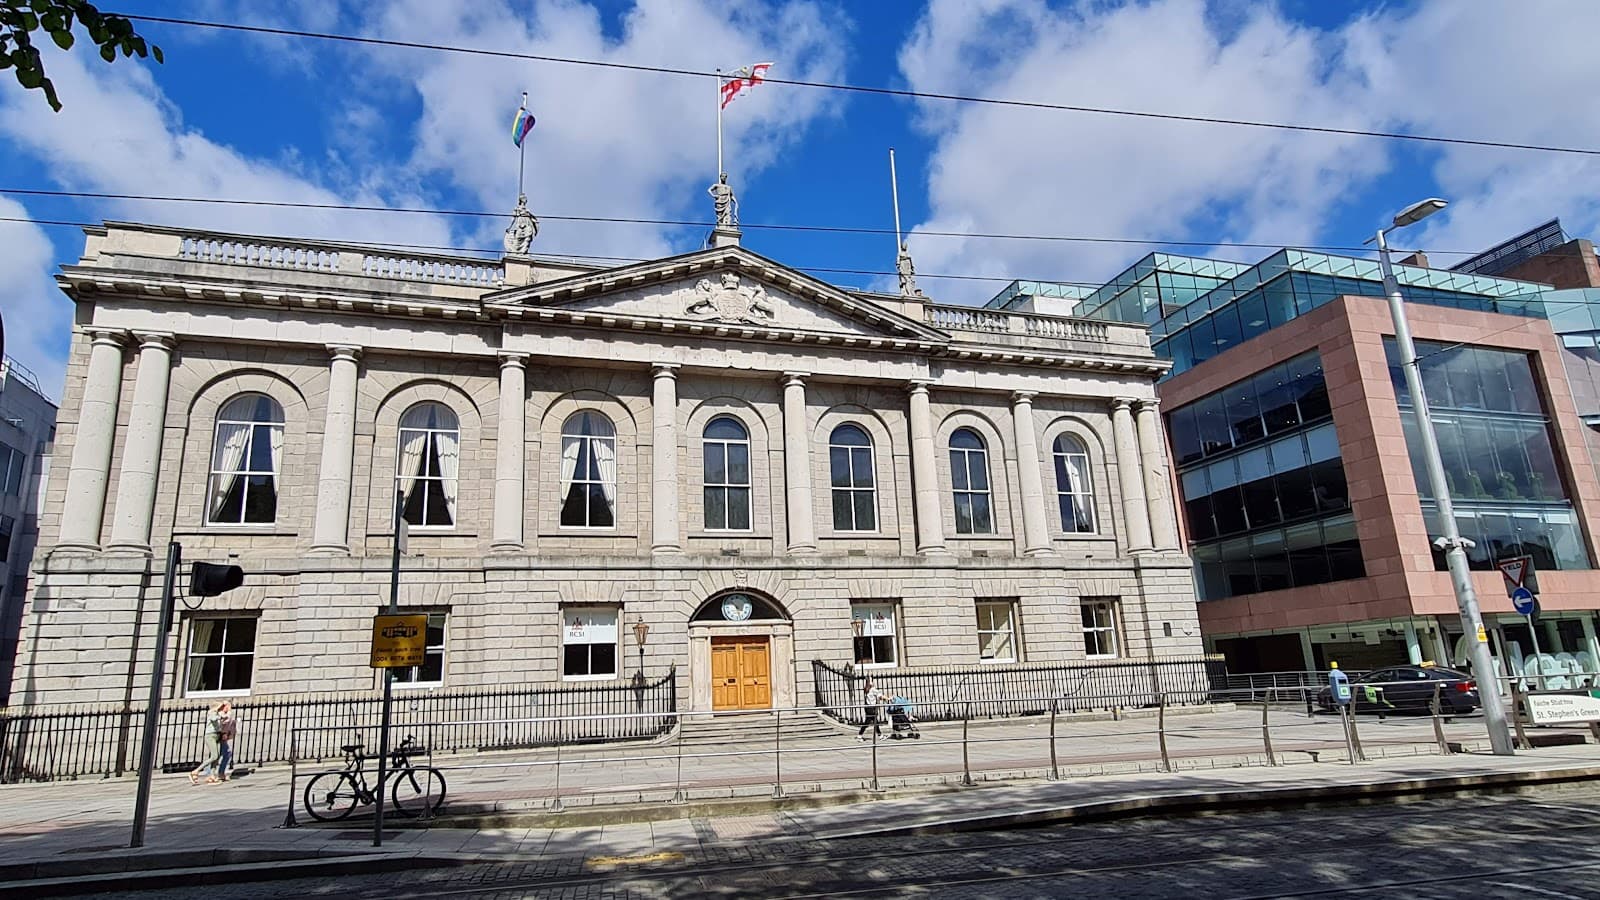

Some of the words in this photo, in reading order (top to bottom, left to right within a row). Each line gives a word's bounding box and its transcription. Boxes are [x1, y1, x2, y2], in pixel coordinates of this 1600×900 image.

[1502, 562, 1521, 571] YIELD
[1547, 709, 1580, 719] Stephen's
[1580, 708, 1600, 717] Green
